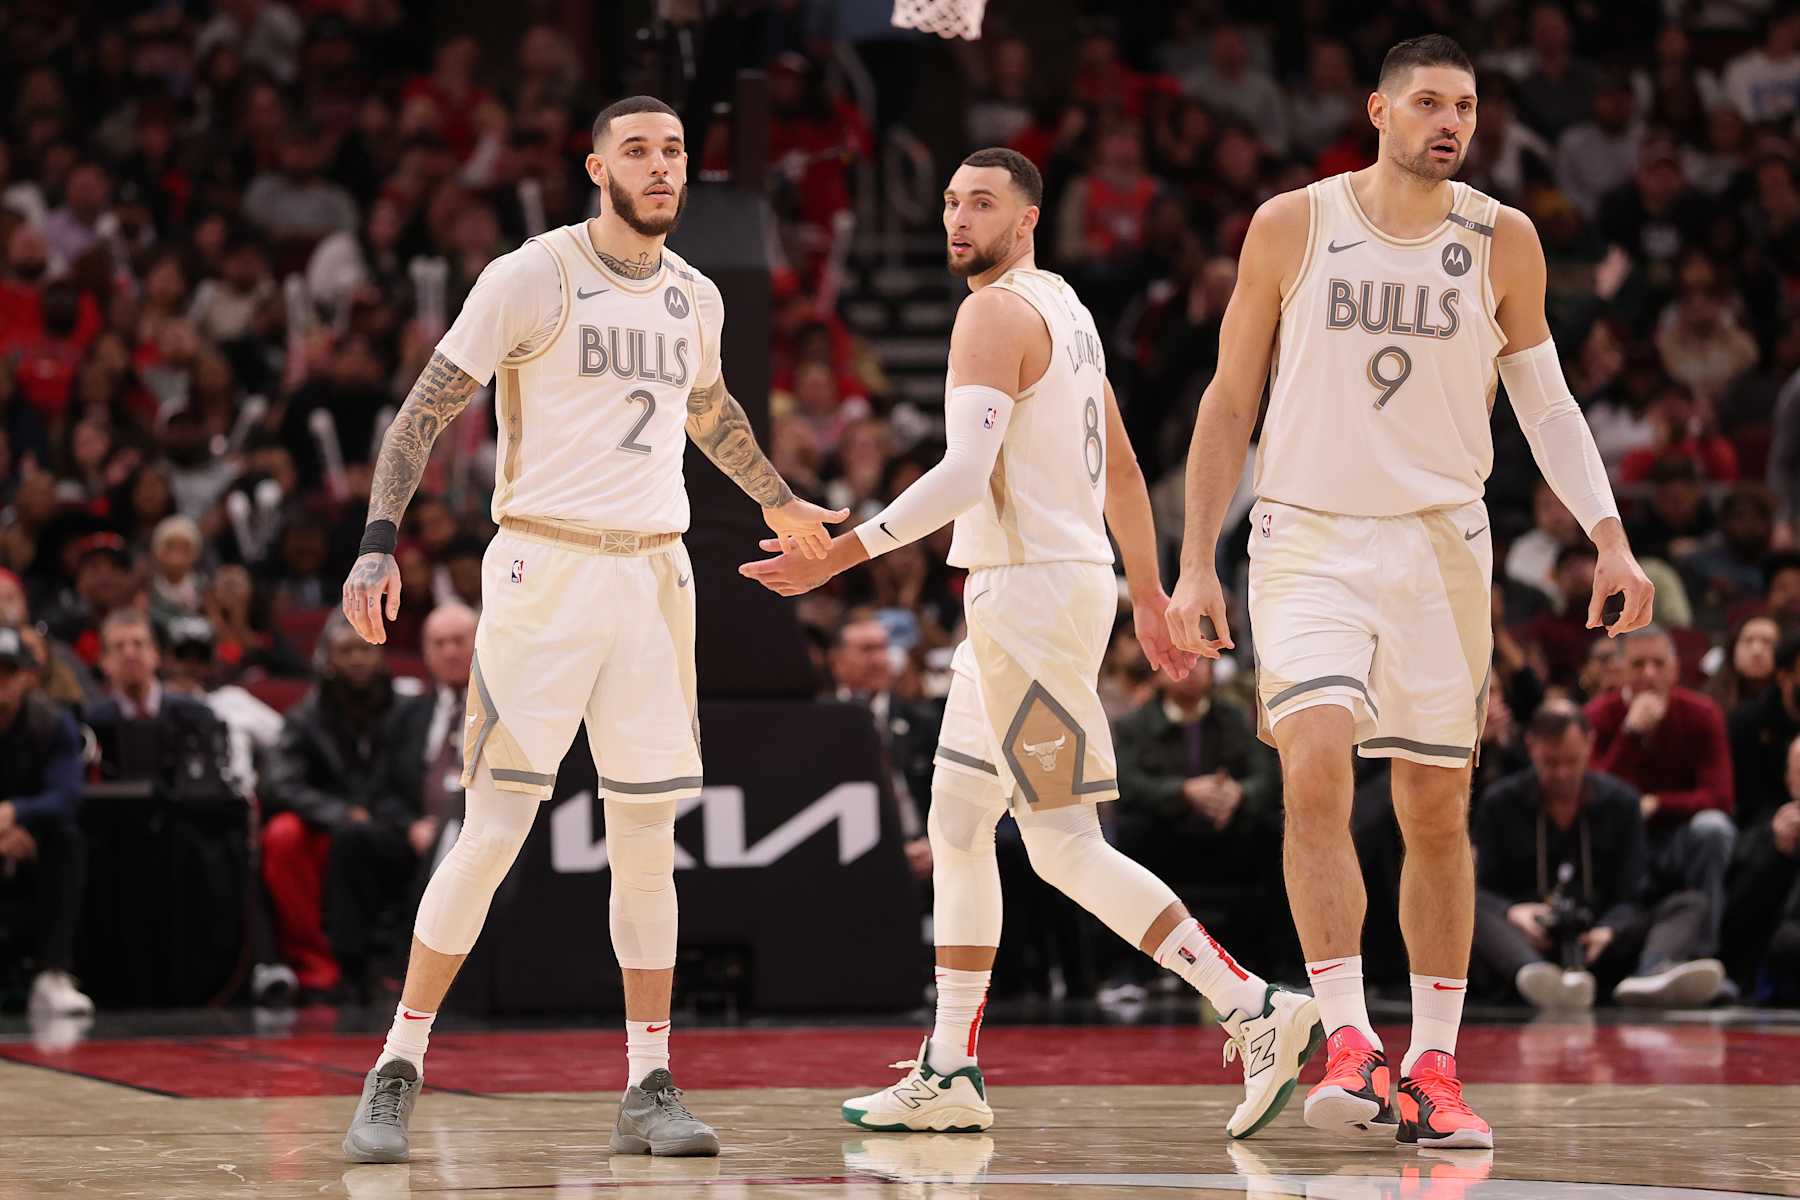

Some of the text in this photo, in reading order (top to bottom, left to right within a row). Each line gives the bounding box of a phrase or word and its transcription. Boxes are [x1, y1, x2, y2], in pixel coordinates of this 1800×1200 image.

[1326, 278, 1460, 340] BULLS
[579, 324, 688, 388] BULLS
[1367, 346, 1412, 410] 9
[617, 389, 656, 455] 2
[1084, 396, 1103, 487] 8
